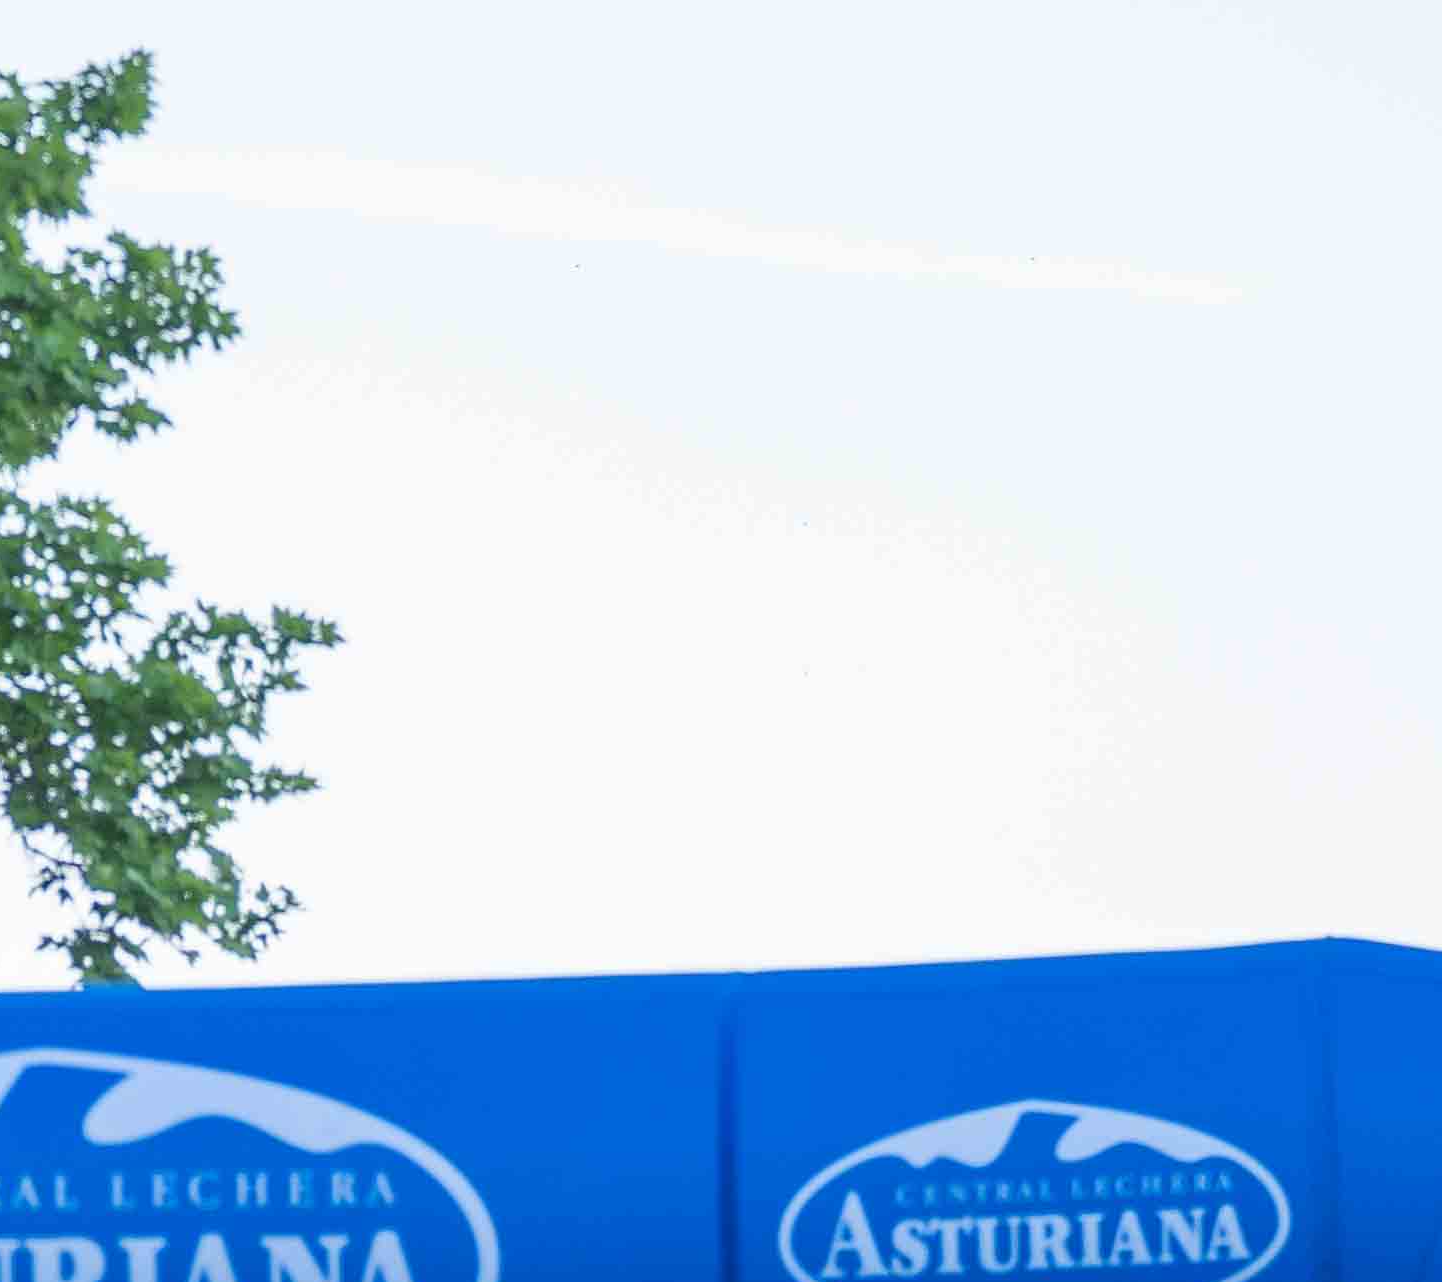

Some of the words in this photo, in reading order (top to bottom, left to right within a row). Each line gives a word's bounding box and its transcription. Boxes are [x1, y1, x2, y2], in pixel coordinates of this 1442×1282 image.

[110, 1170, 398, 1211] LECHERA
[896, 1178, 1053, 1207] CENTRAL
[1070, 1170, 1233, 1200] LECHERA
[820, 1189, 1251, 1279] ASTURIANA
